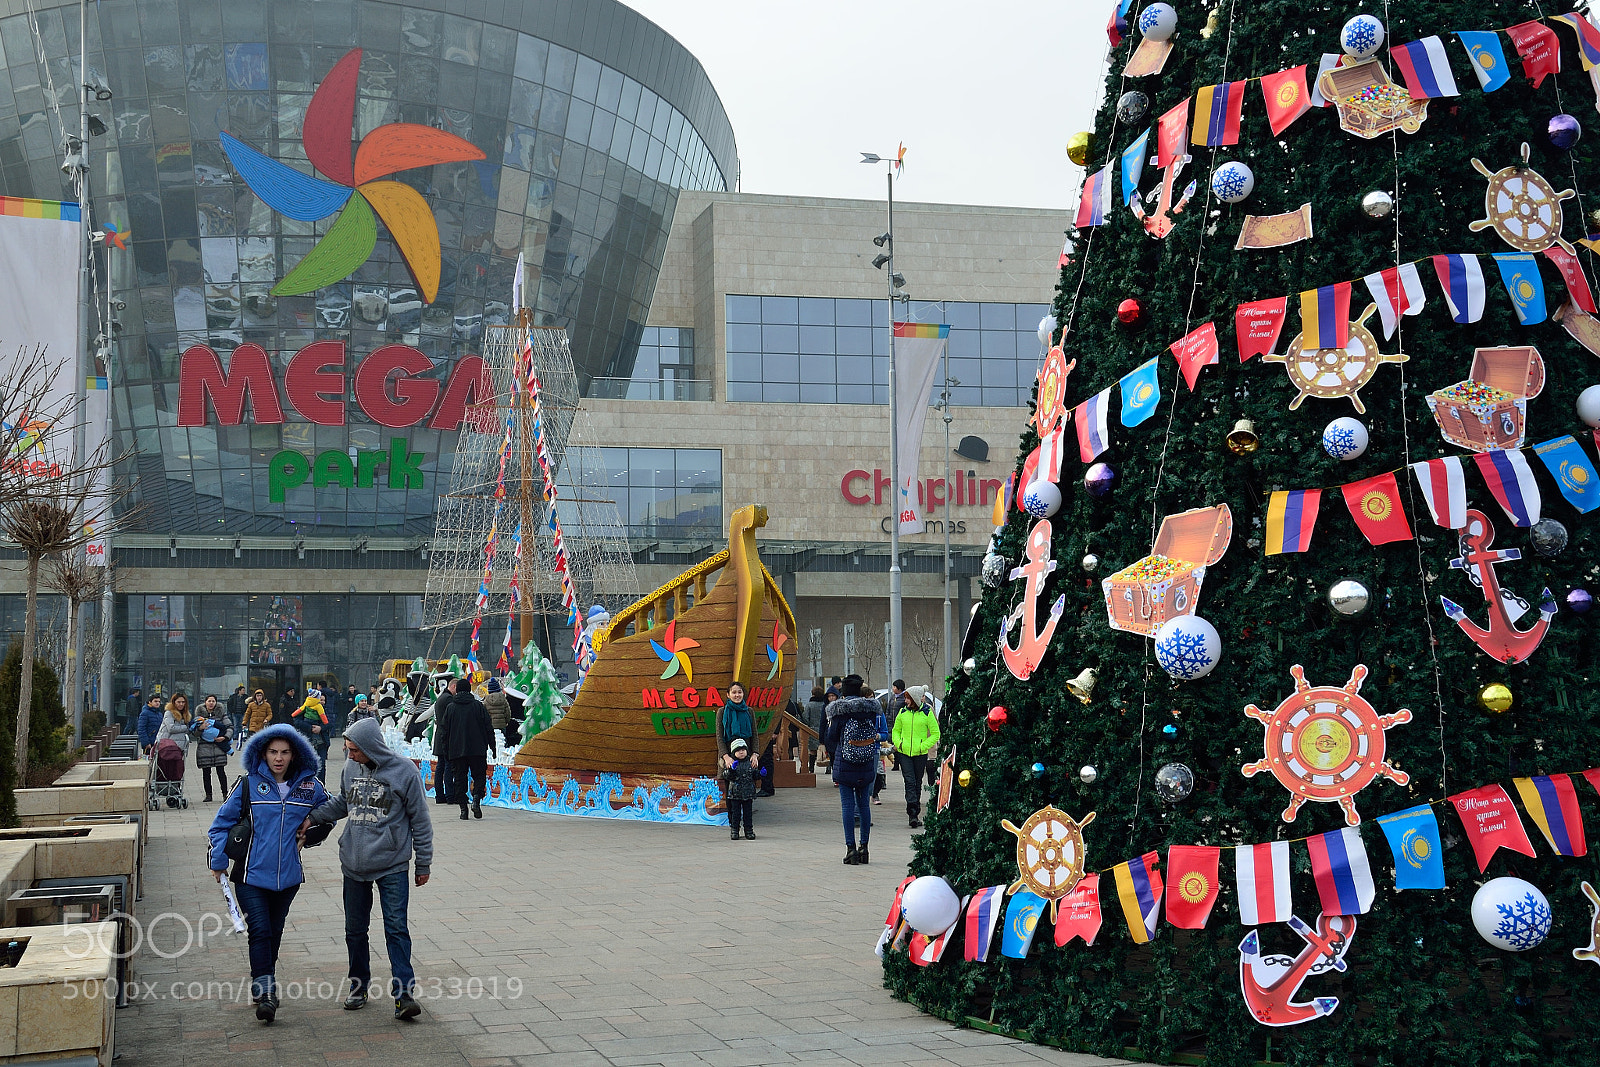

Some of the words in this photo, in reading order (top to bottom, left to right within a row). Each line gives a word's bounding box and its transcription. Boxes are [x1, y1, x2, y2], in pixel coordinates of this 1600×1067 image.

[177, 339, 501, 435] MEGA
[841, 469, 1002, 513] Chplin
[642, 686, 725, 709] MEGA
[746, 686, 783, 708] MEGA
